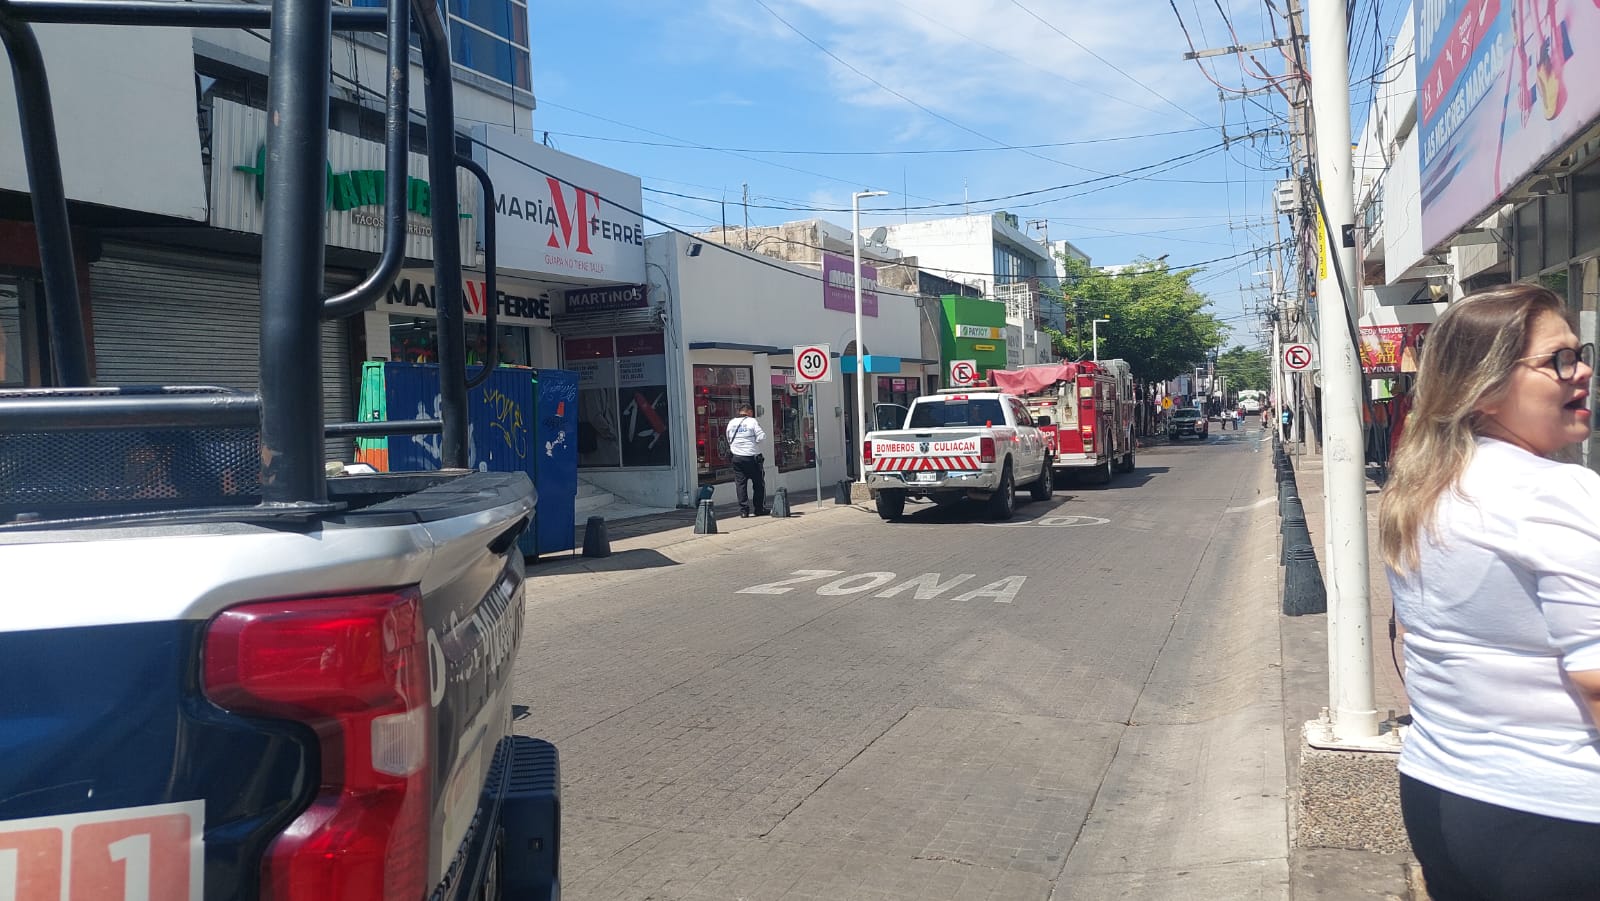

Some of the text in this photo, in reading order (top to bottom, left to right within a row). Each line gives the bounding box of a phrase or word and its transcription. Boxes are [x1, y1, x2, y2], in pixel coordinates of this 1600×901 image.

[1465, 31, 1504, 112] MARCAS
[968, 327, 988, 337] PAYJOY
[803, 354, 822, 369] 30
[876, 441, 975, 453] BOMBEROS CULIACAN
[734, 569, 1027, 603] ZONA
